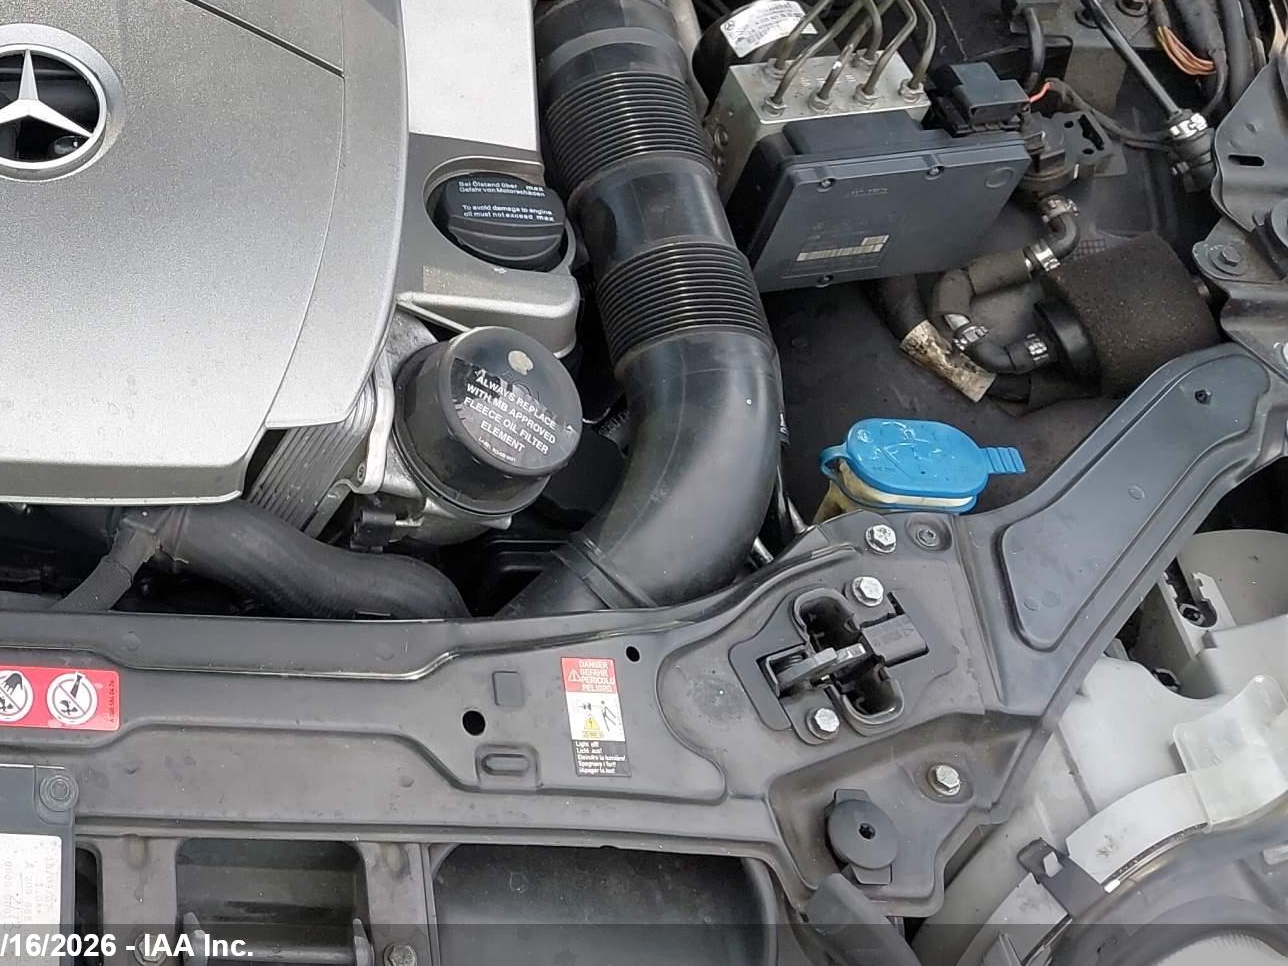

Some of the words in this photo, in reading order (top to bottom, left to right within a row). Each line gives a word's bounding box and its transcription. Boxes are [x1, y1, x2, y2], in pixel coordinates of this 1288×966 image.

[492, 204, 520, 213] damage
[529, 208, 552, 216] engine
[463, 396, 502, 424] FLEECE
[503, 418, 518, 434] OIL
[519, 429, 549, 454] FILTER
[466, 383, 492, 403] WITH
[493, 397, 508, 412] MB
[509, 409, 556, 444] APPROVED
[475, 376, 516, 403] ALWAYS
[516, 397, 557, 430] REPLACE
[480, 420, 526, 452] ELEMENT
